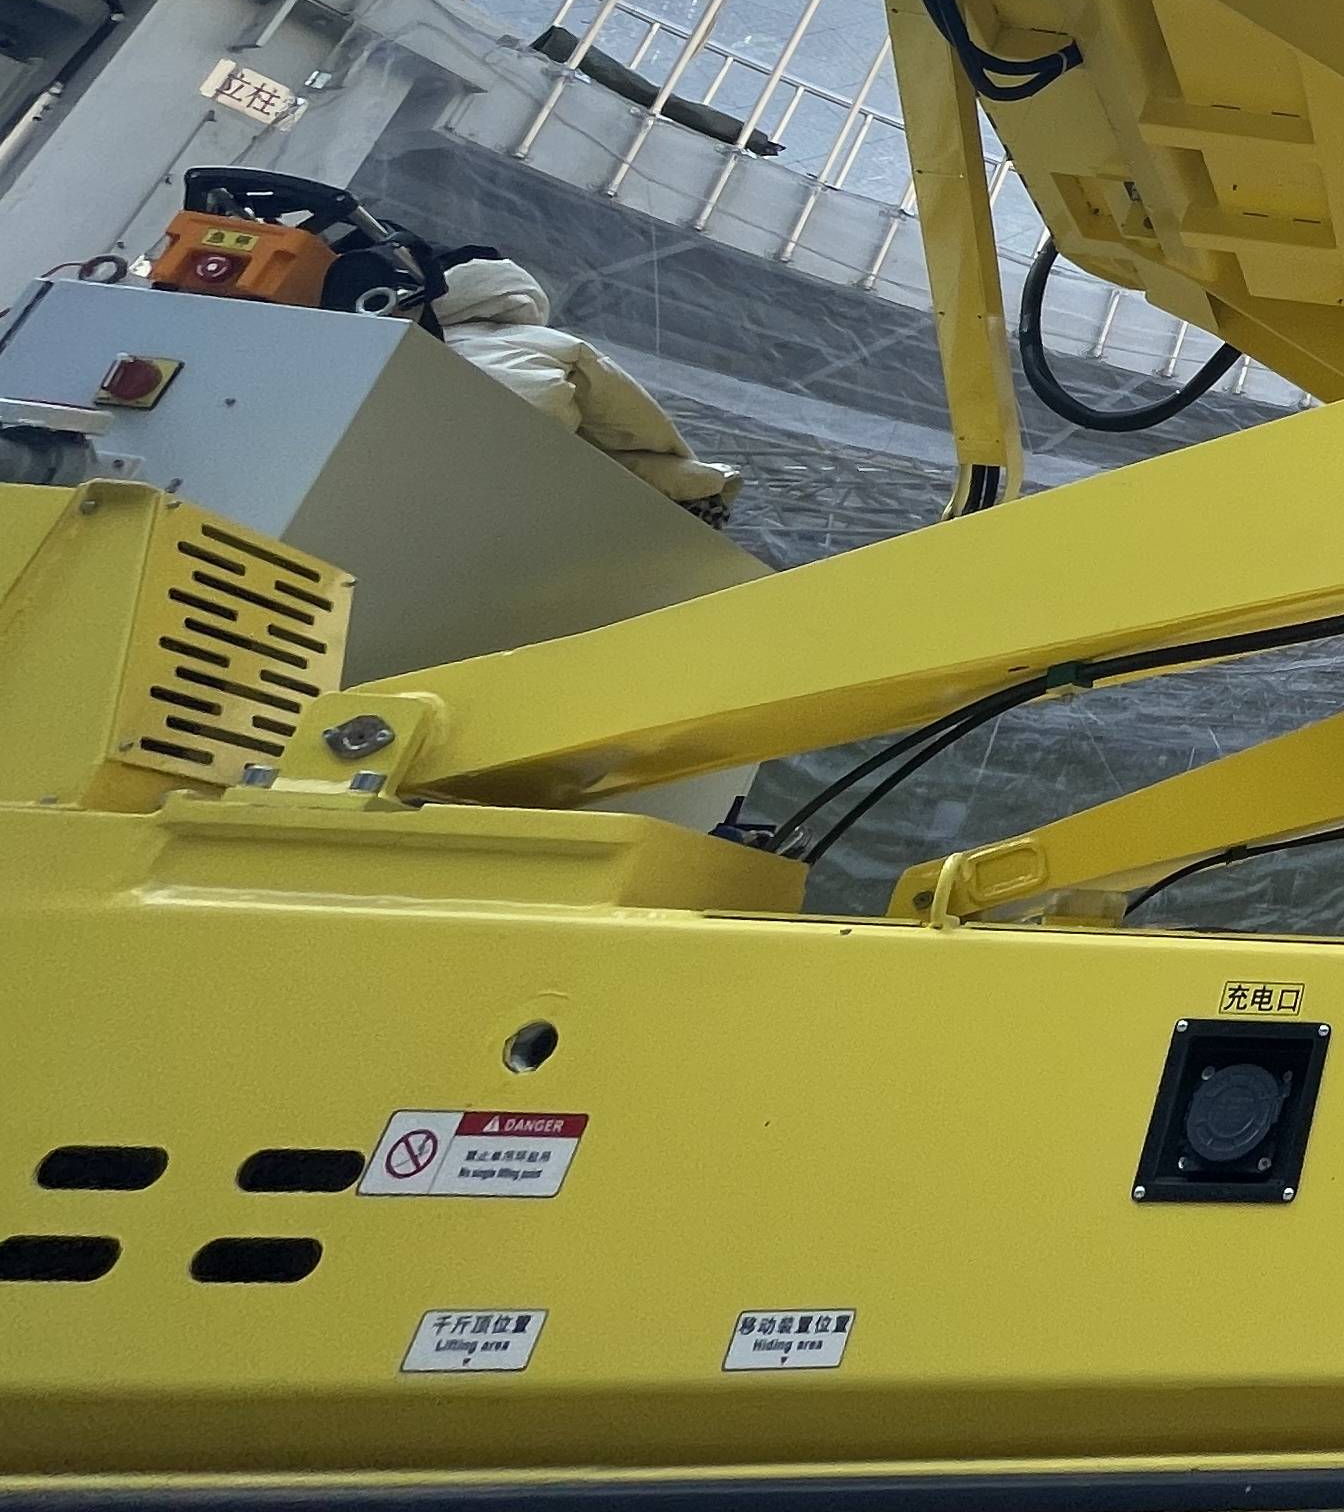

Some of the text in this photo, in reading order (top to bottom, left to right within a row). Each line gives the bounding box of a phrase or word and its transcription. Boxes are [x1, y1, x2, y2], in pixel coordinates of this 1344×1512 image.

[1223, 984, 1300, 1012] 充电口
[504, 1118, 565, 1133] DANGER
[433, 1315, 532, 1335] 千斤顶位置
[739, 1315, 850, 1335] 移动装置位置
[434, 1338, 511, 1354] Lifting area
[752, 1338, 823, 1354] Hiding area
